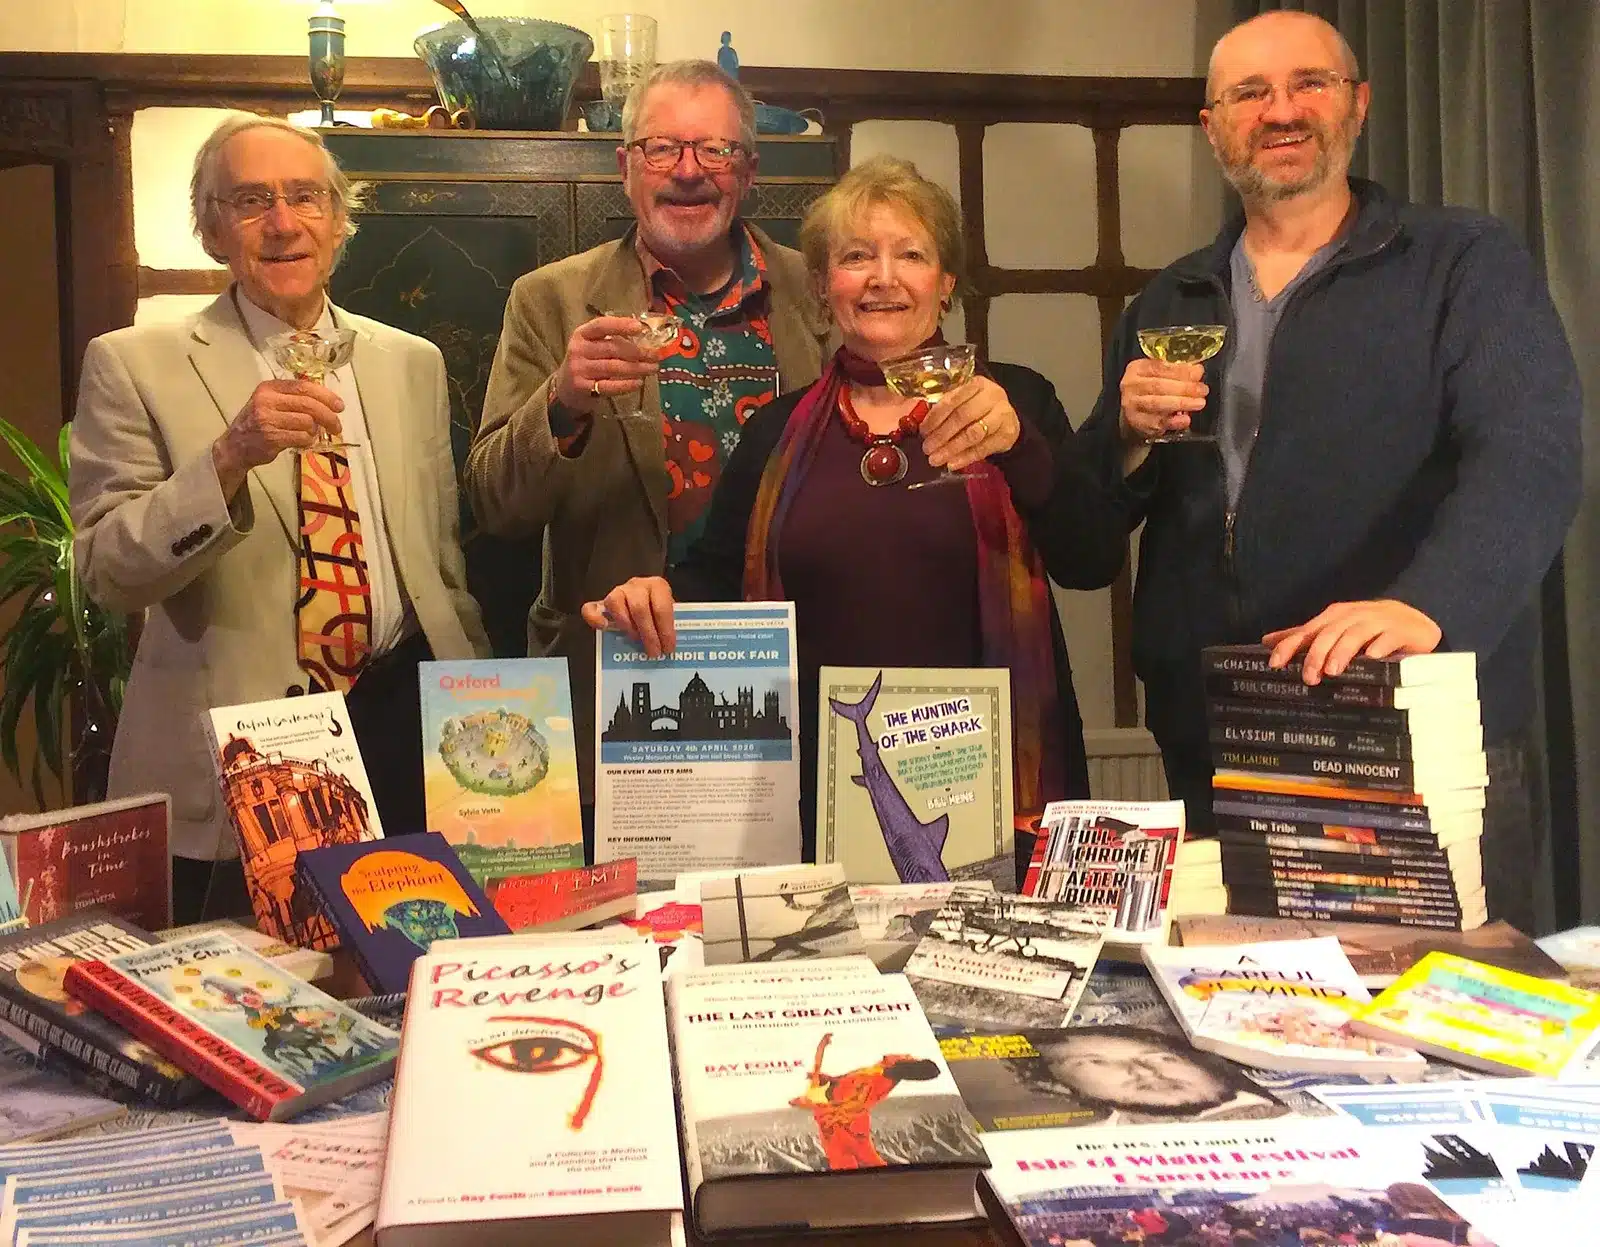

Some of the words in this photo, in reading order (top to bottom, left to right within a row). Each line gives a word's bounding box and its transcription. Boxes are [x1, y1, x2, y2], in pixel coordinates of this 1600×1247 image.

[612, 652, 666, 662] OXFOD
[670, 652, 705, 661] INDIE
[708, 651, 746, 661] BOOK
[749, 650, 779, 660] FAIR
[440, 673, 501, 689] Oxford
[884, 712, 908, 728] THE
[911, 699, 970, 723] HUNTING
[881, 734, 899, 749] OF
[903, 729, 928, 745] THE
[930, 717, 982, 739] SHARK
[1225, 727, 1276, 742] ELYSIUM
[1283, 732, 1337, 748] BURNING
[632, 745, 681, 753] SATURDAY
[1222, 753, 1242, 763] TIM
[1243, 755, 1281, 767] LAURIE
[1313, 759, 1343, 774] DEAD
[1345, 762, 1401, 778] INNOCENT
[459, 808, 480, 817] Sylvia
[481, 807, 501, 815] Vetta
[926, 797, 948, 810] BILL
[1249, 819, 1268, 832] The
[1271, 821, 1297, 834] Tribe
[62, 827, 151, 859] Brushstrokes
[1068, 829, 1110, 844] FULL
[1075, 846, 1150, 863] CHROME
[88, 860, 129, 878] Time
[358, 863, 421, 879] Sculpting
[351, 886, 367, 896] the
[368, 873, 445, 893] Elephant
[1066, 870, 1126, 887] AFTER
[1065, 888, 1118, 905] BURN
[430, 952, 641, 985] Picasso's
[430, 981, 638, 1009] Revenge
[687, 1011, 725, 1024] THE
[729, 1010, 777, 1020] LAST
[782, 1007, 844, 1019] GREAT
[850, 1002, 913, 1014] EVENT
[704, 1062, 739, 1073] RAY
[744, 1059, 805, 1071] FOULK
[1016, 1158, 1078, 1172] Isle
[1086, 1156, 1117, 1169] of
[1125, 1151, 1222, 1169] Wight
[1230, 1147, 1361, 1165] Festival
[106, 1180, 153, 1194] INDIE
[159, 1171, 206, 1185] BOOK
[212, 1163, 251, 1177] FAIR
[1112, 1169, 1297, 1184] Experience
[165, 1202, 217, 1218] BOOK
[221, 1194, 262, 1209] FAIR
[241, 1225, 283, 1240] FAIR
